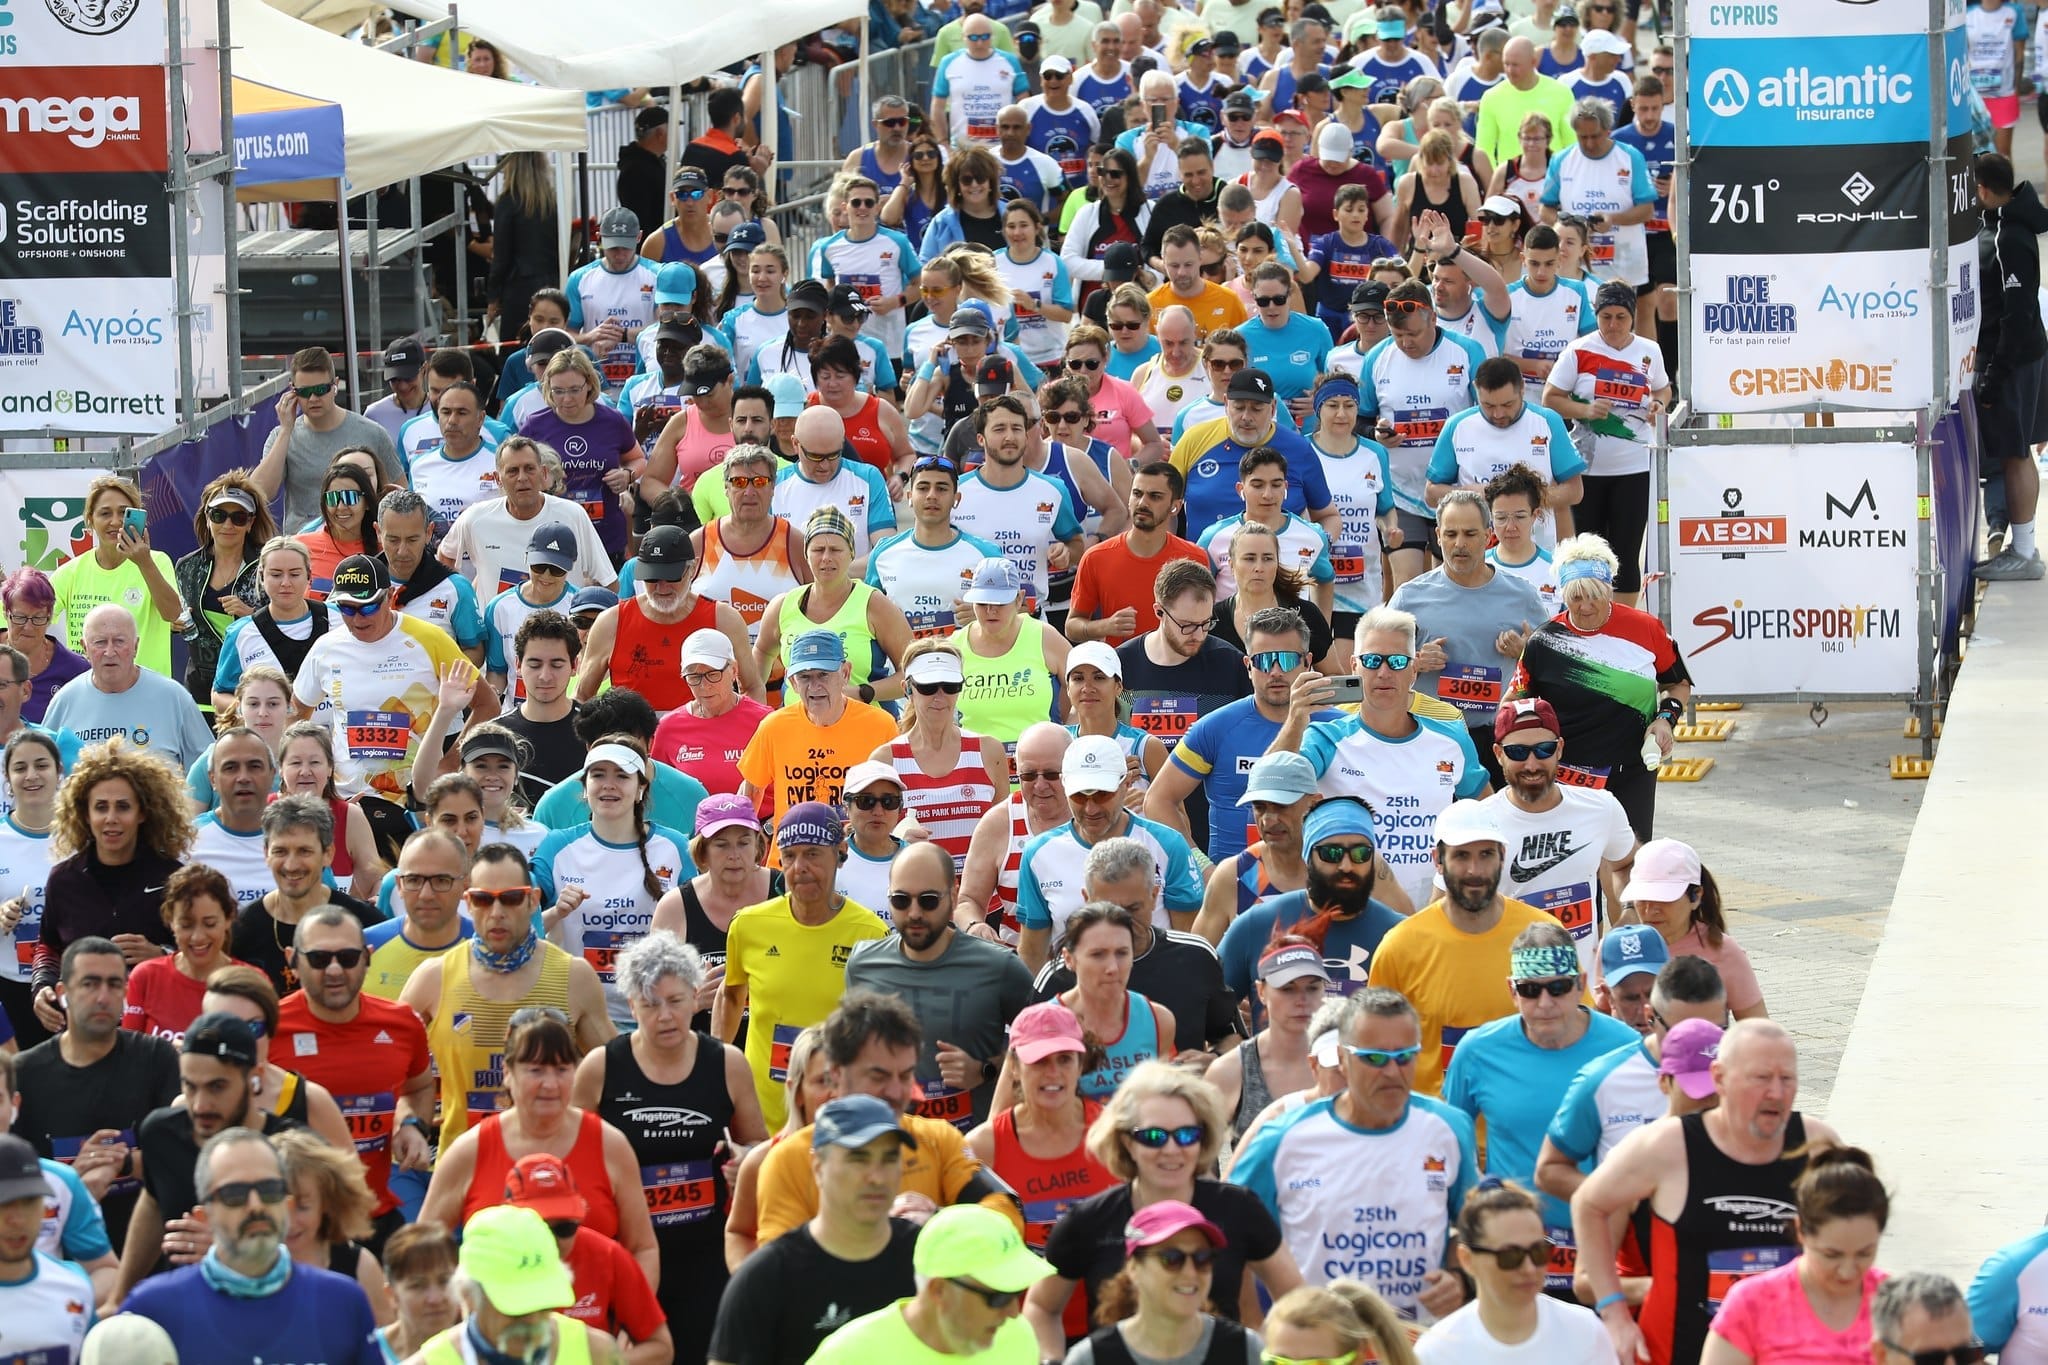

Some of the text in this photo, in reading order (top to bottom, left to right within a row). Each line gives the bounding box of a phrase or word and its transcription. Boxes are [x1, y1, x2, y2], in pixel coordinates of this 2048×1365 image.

[1710, 4, 1778, 26] CYPRUS
[1758, 64, 1913, 108] atlantic
[1796, 107, 1875, 121] insurance
[1585, 190, 1605, 198] 25th
[16, 200, 148, 225] Scaffolding
[1572, 202, 1620, 213] Logicom
[1797, 209, 1918, 223] RONHILL
[17, 223, 125, 244] Solutions
[18, 250, 69, 258] OFFSHORE
[79, 249, 126, 257] ONSHORE
[1726, 274, 1771, 304] ICE
[1818, 282, 1919, 319] Αγρός
[608, 308, 628, 316] 25th
[1703, 303, 1798, 335] POWER
[62, 309, 163, 345] Αγρός
[1522, 338, 1568, 350] Logicom
[1709, 336, 1791, 348] For fast pain relief
[15, 357, 38, 366] relief
[1602, 381, 1637, 397] 3107
[1406, 395, 1431, 405] 25th
[440, 498, 463, 506] 25th
[995, 531, 1020, 540] 25th
[1799, 529, 1906, 548] MAURTEN
[1001, 541, 1036, 555] icom
[336, 574, 370, 585] CYPRUS
[915, 596, 941, 605] 25th
[1821, 641, 1844, 653] 104.0
[245, 650, 265, 664] PAFOS
[1449, 680, 1492, 697] 3095
[1456, 701, 1482, 709] Logicom
[1141, 715, 1186, 730] 3210
[356, 728, 399, 743] 3332
[362, 749, 389, 757] Logicom
[808, 748, 835, 759] 24th
[1386, 796, 1420, 808] 25th
[932, 808, 949, 817] PARK
[951, 805, 981, 815] HARRIERS
[1520, 831, 1572, 859] NIKE
[560, 876, 585, 884] PAFOS
[604, 898, 635, 909] 25th
[632, 1112, 681, 1122] Kingstone
[644, 1129, 694, 1138] Barnsley
[1027, 1169, 1090, 1194] CLAIRE
[645, 1183, 701, 1206] 3245
[1354, 1206, 1397, 1223] 25th
[1729, 1221, 1785, 1233] Barnsley
[1323, 1227, 1426, 1256] Logicom
[1324, 1258, 1426, 1279] CYPRUS
